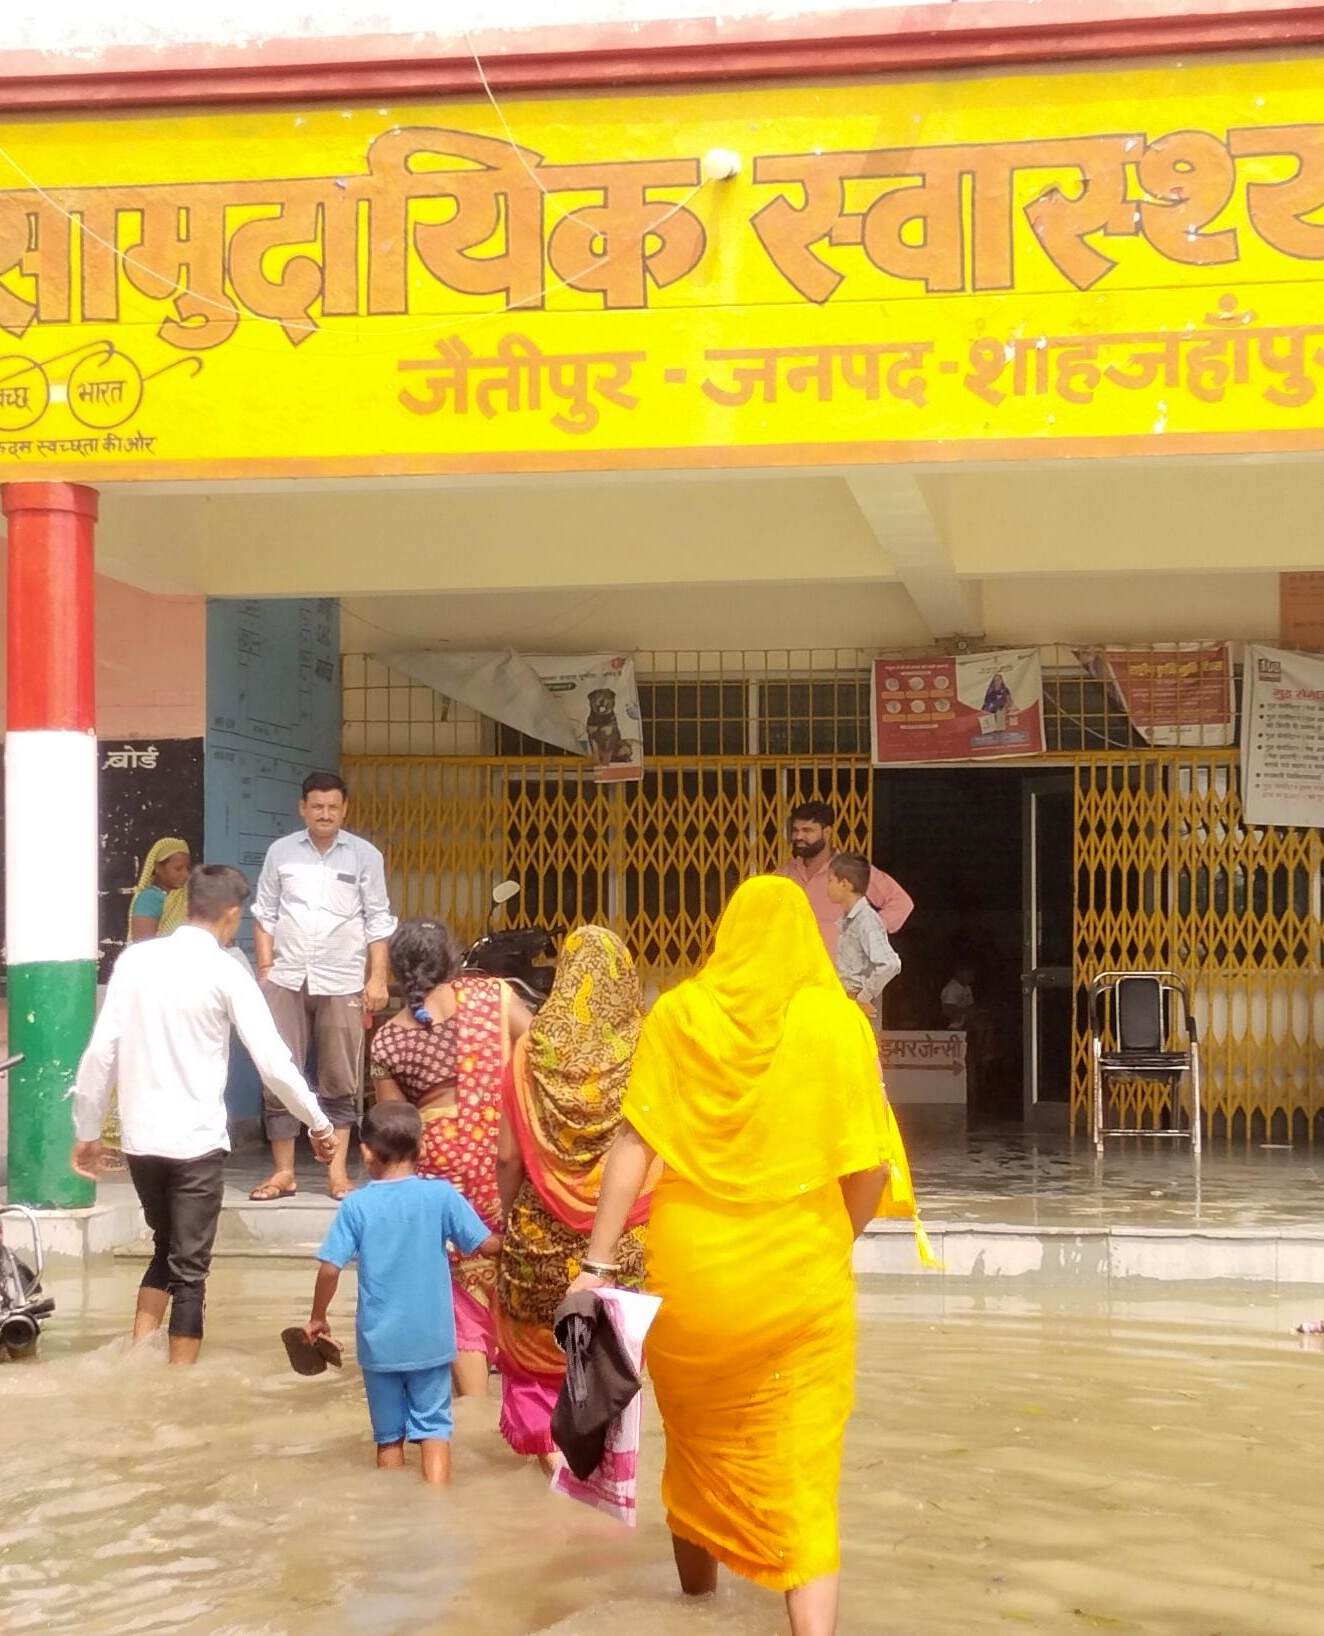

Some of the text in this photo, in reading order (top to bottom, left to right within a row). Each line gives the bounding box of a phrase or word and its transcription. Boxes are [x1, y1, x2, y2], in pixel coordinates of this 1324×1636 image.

[78, 380, 128, 406] भारत
[397, 333, 647, 435] जैतीपुर
[102, 432, 123, 452] की
